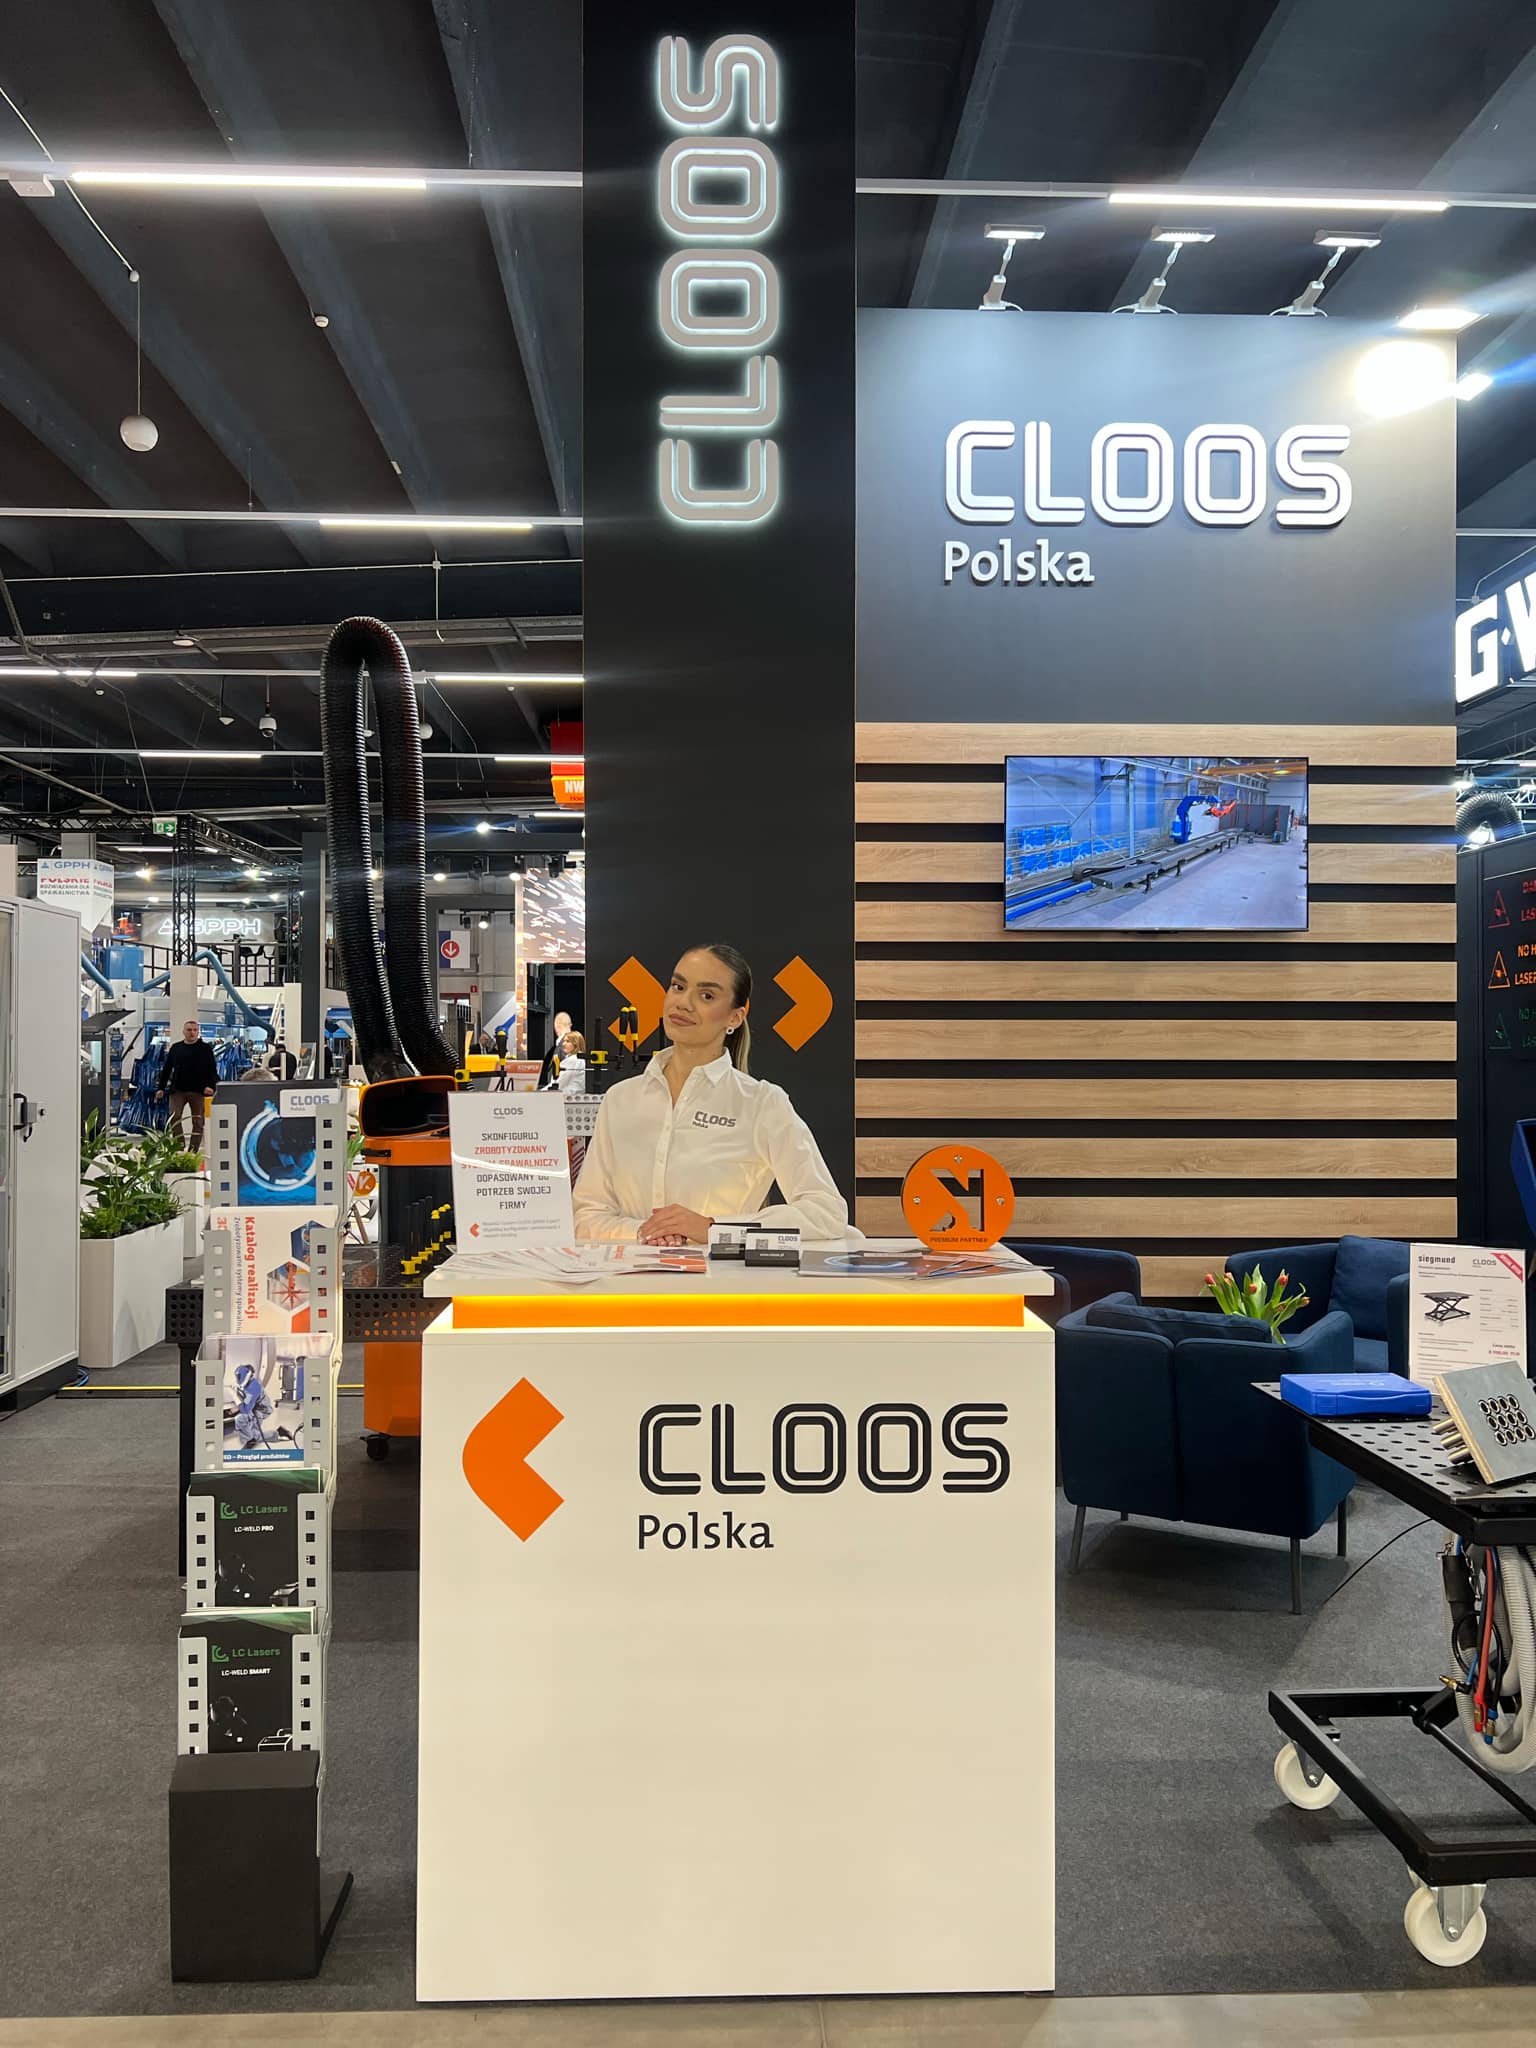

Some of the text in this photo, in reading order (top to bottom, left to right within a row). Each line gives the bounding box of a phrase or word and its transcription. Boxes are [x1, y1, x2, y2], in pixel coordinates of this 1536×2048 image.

[660, 33, 780, 524] CLOOS
[945, 419, 1353, 527] CLOOS
[943, 537, 1096, 586] Polska
[54, 861, 91, 869] GPPH
[1517, 944, 1530, 957] NO
[290, 1095, 330, 1106] CLOOS
[493, 1107, 524, 1116] CLOOS
[694, 1111, 737, 1128] CLOOS
[481, 1132, 539, 1142] SKONFIGURUJ
[474, 1145, 548, 1156] ZROBOTYZOWANY
[476, 1185, 552, 1197] POTRZEB SWOJEJ
[499, 1200, 528, 1210] FIRMY
[1418, 1254, 1456, 1264] siegmund
[1472, 1258, 1497, 1266] CLOOS
[245, 1216, 259, 1319] Katalog realizacji
[639, 1402, 1011, 1495] CLOOS
[240, 1505, 288, 1514] LC Lasers
[638, 1511, 775, 1550] Polska
[232, 1648, 281, 1658] LC Lasers
[249, 1667, 272, 1675] SMART
